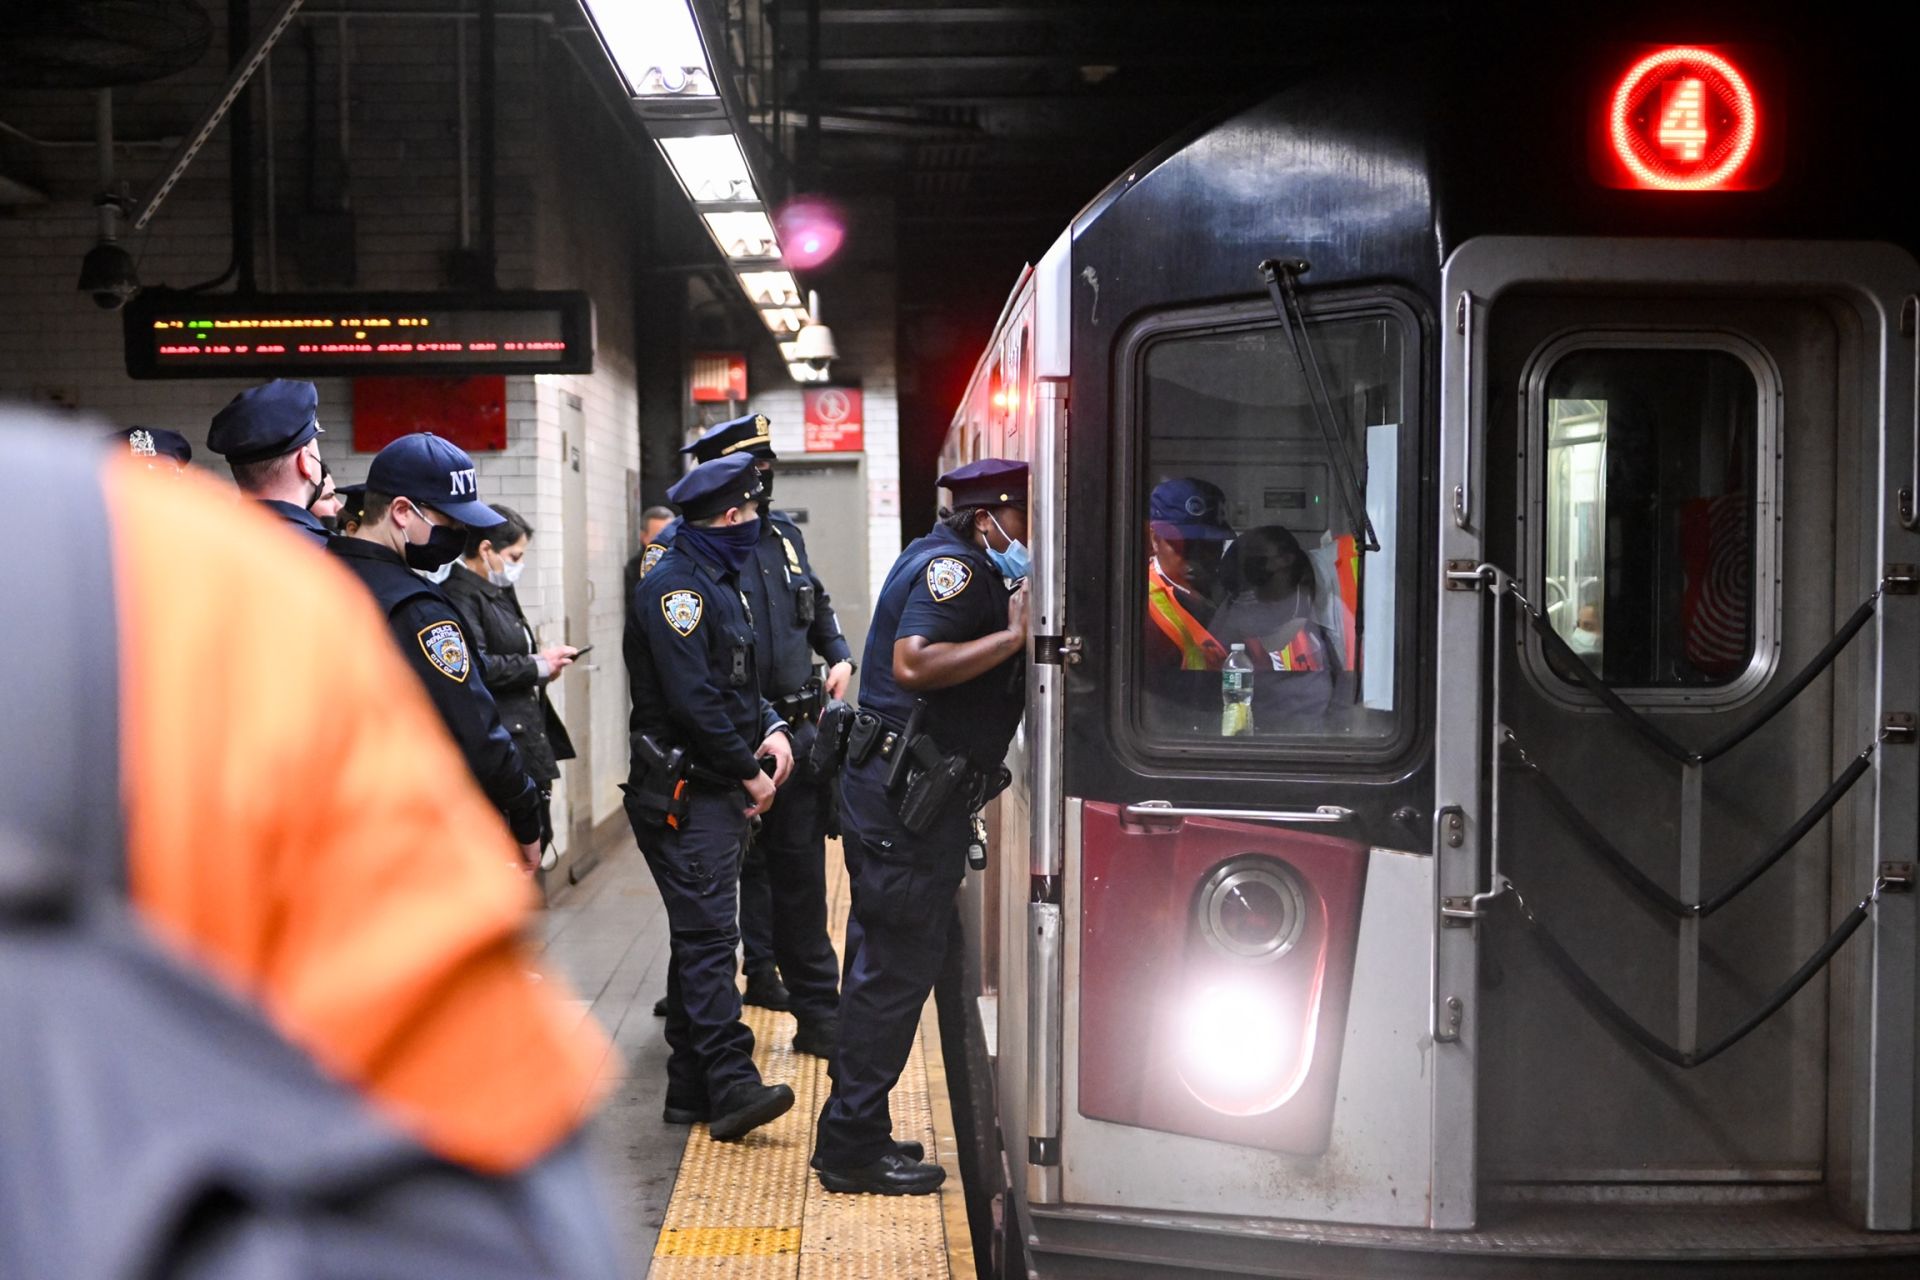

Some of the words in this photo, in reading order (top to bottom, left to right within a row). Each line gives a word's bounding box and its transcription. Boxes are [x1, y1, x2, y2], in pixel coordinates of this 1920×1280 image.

[1660, 79, 1707, 160] 4
[450, 468, 477, 496] NY
[430, 624, 453, 636] POLICE
[430, 653, 444, 667] CITY
[443, 666, 453, 674] OF
